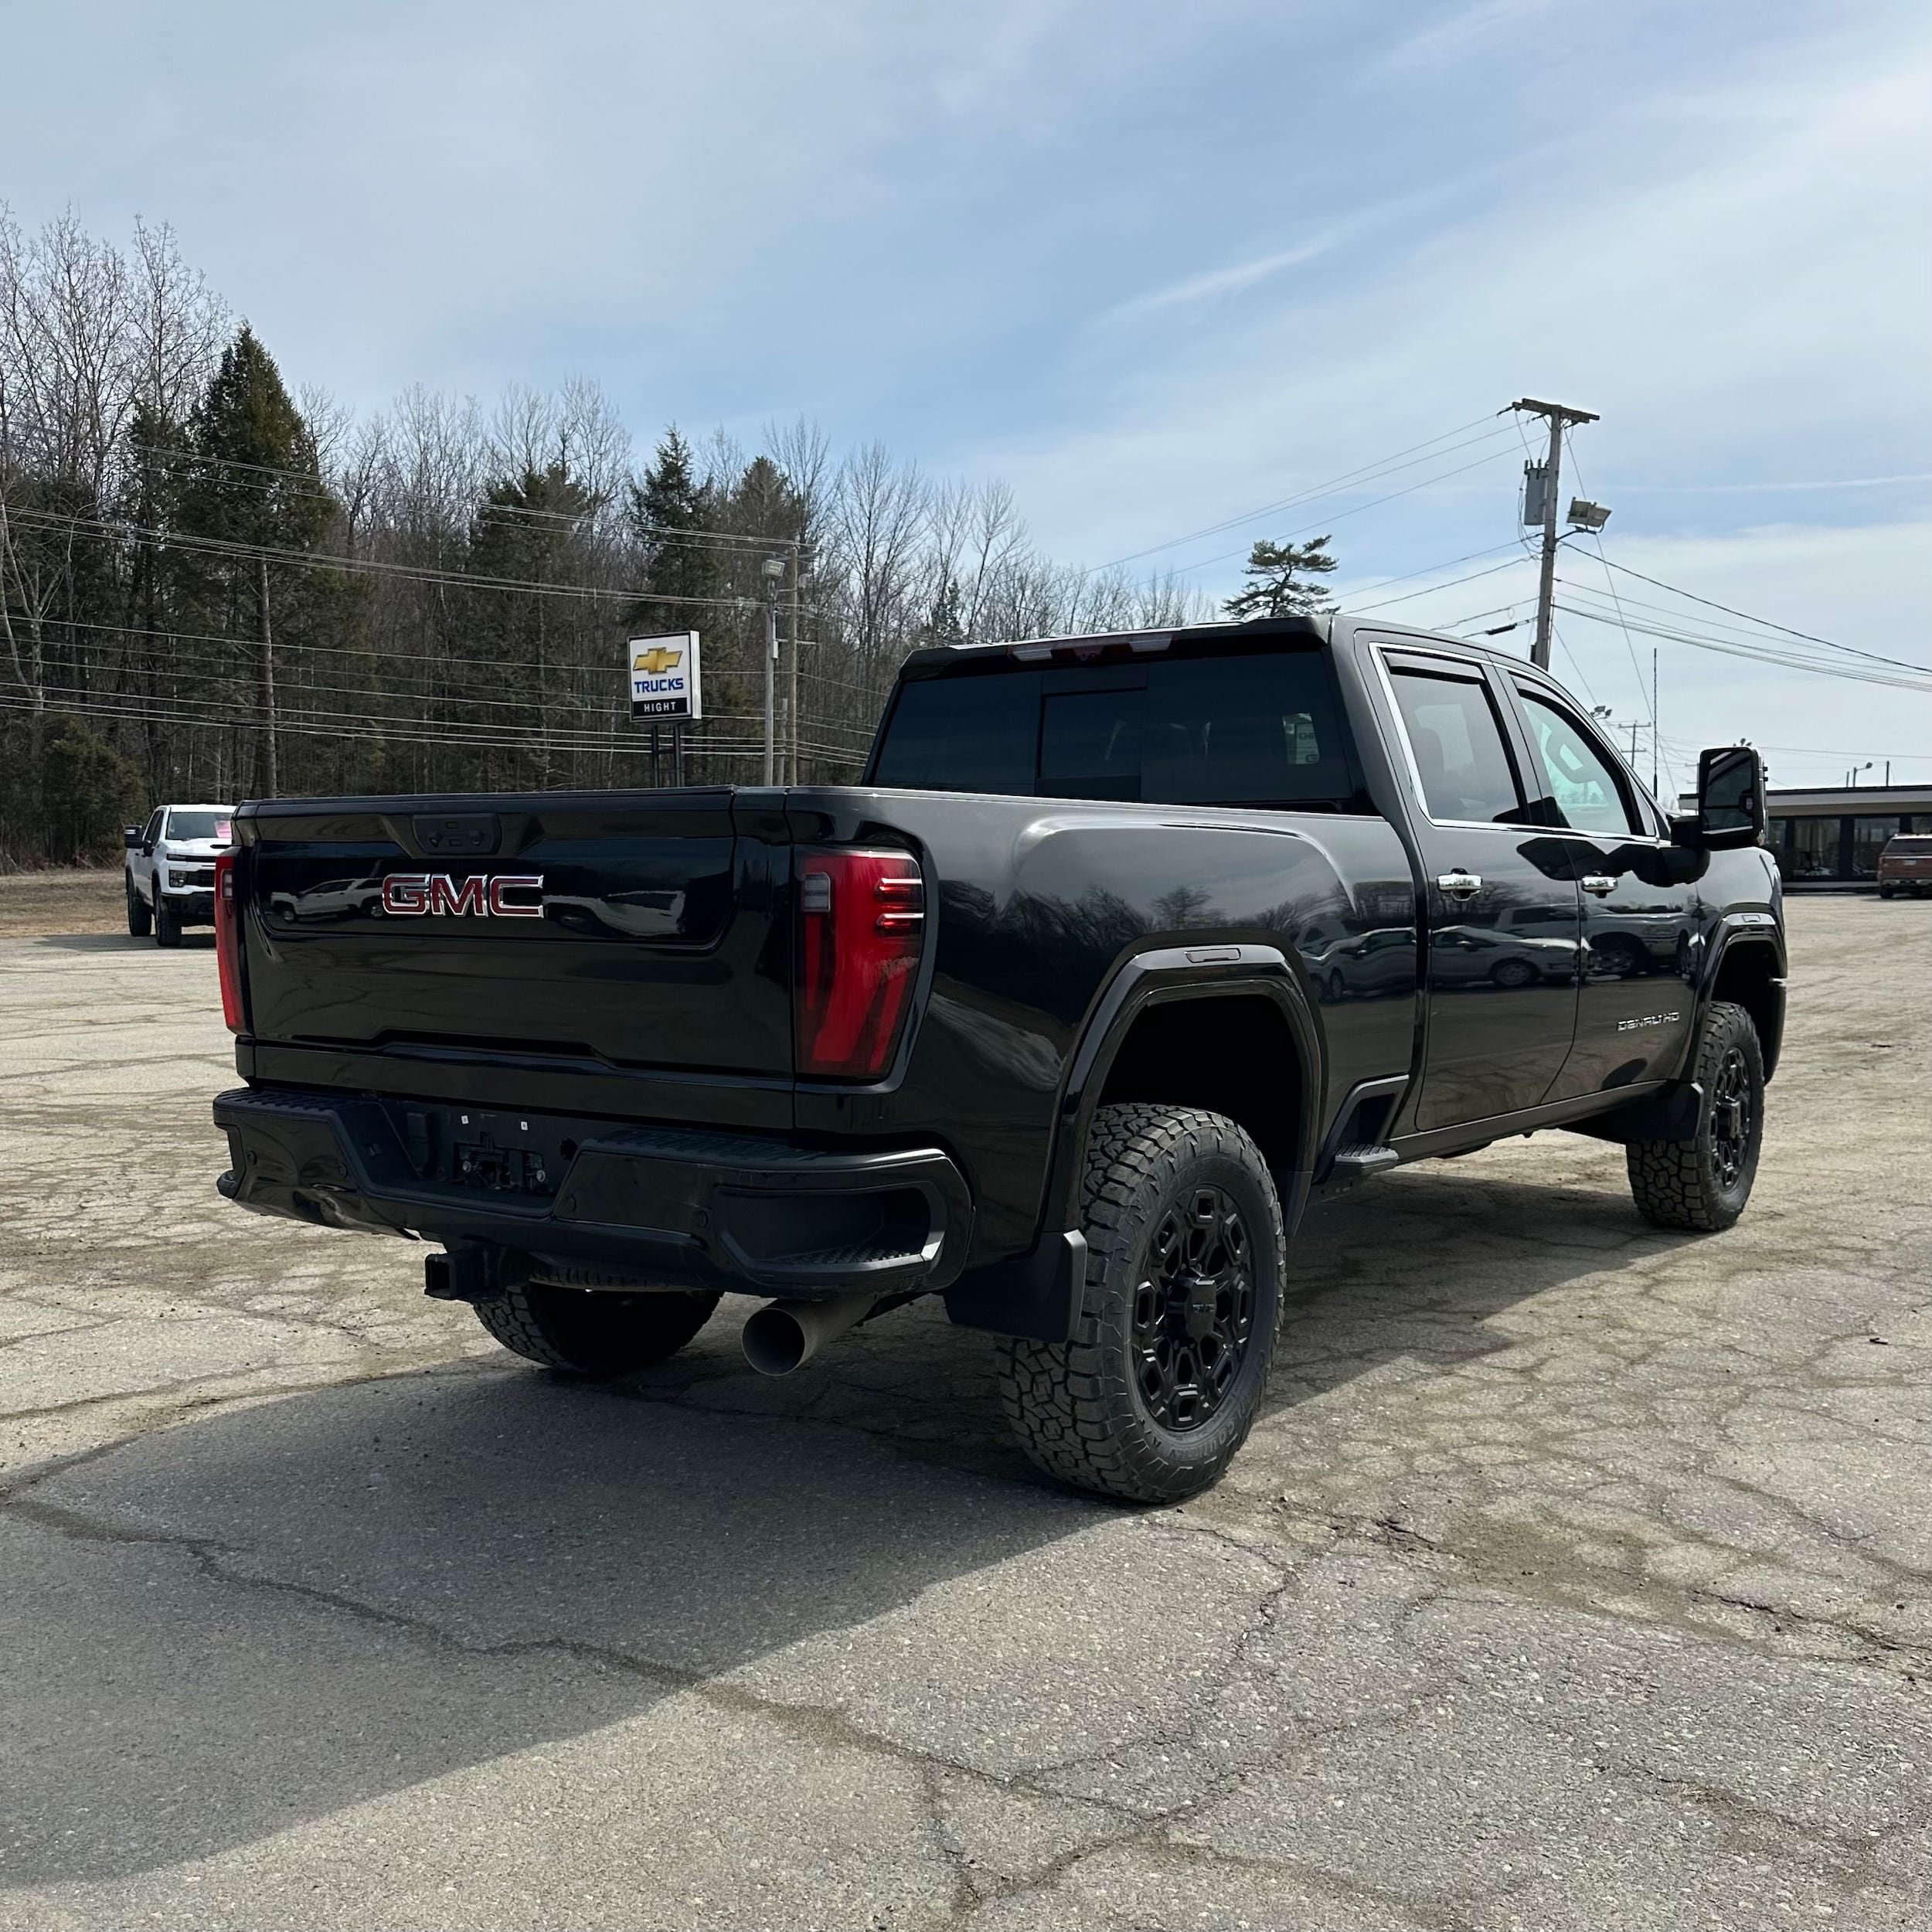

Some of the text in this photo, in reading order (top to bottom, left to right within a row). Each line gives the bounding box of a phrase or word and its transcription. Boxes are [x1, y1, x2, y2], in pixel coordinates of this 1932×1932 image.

[634, 678, 683, 693] TRUCKS
[644, 702, 676, 713] HIGHT
[382, 873, 544, 919] GMC
[1617, 1012, 1679, 1031] DENALI HD
